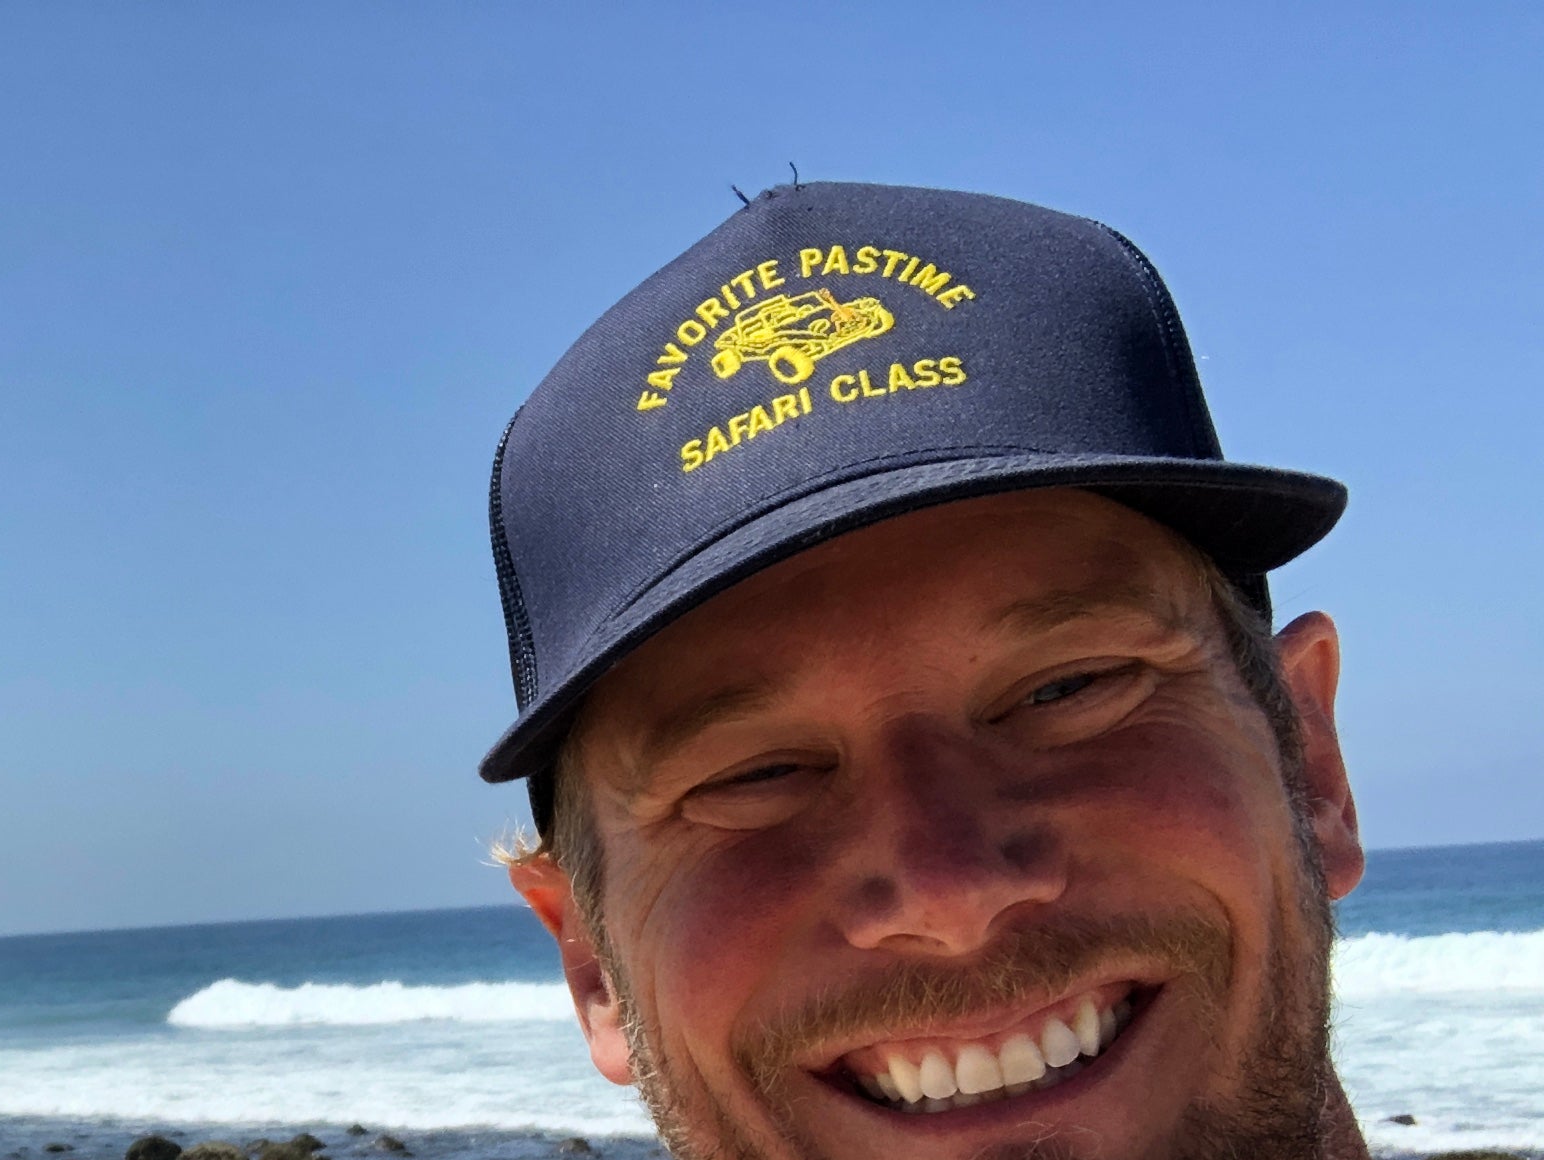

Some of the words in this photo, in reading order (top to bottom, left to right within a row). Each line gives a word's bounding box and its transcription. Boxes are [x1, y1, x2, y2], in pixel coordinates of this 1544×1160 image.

[637, 259, 785, 411] FAVORITE
[800, 245, 976, 310] PASTIME
[680, 386, 812, 473] SAFARI
[829, 356, 967, 403] CLASS
